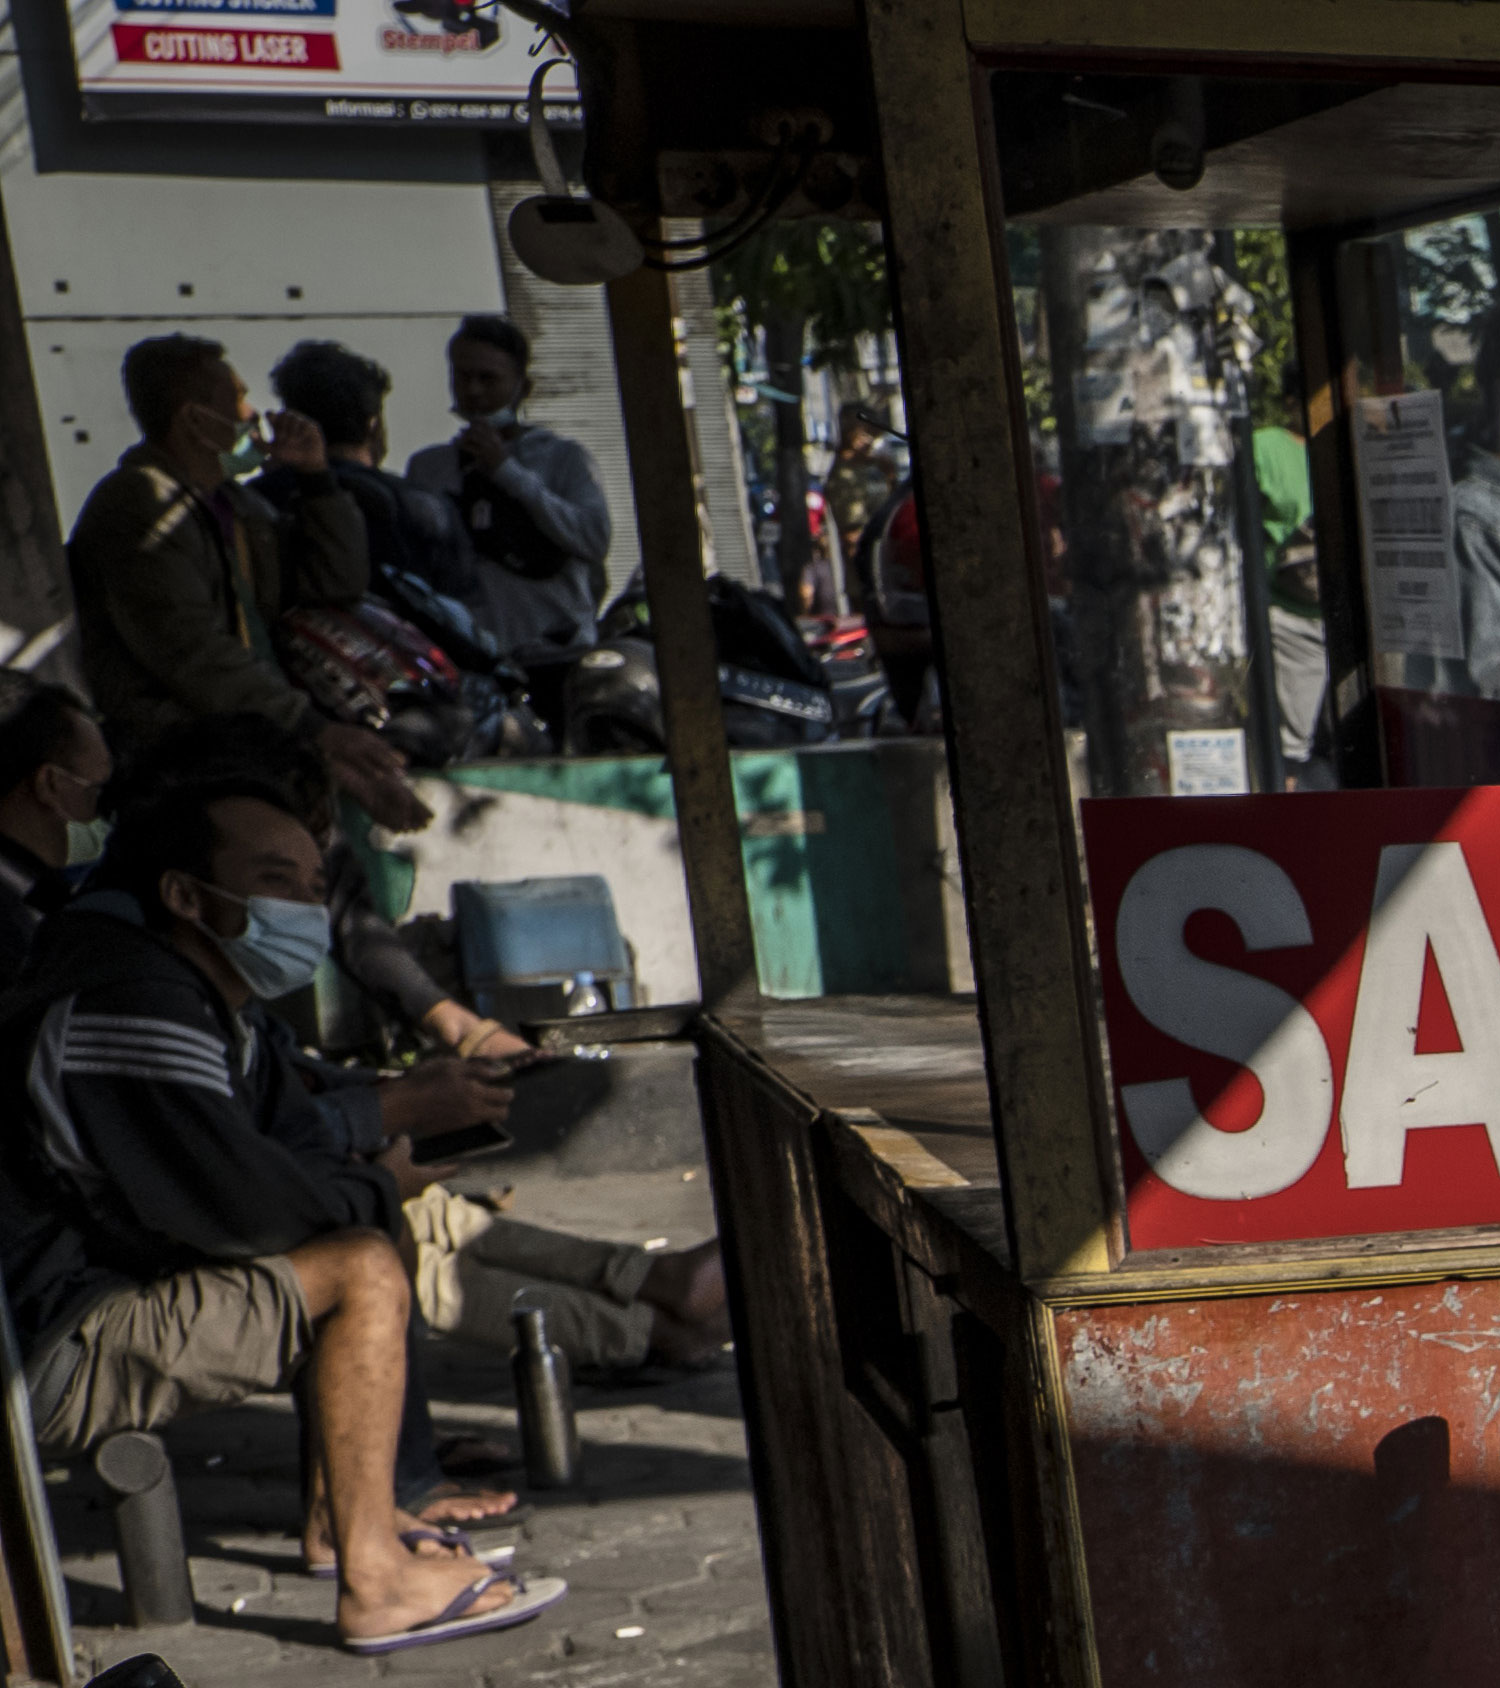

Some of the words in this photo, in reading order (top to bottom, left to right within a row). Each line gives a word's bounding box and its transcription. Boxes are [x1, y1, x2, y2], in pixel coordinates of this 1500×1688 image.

[143, 32, 237, 61] CUTTING
[239, 35, 309, 64] LASER
[383, 28, 479, 54] Stempel
